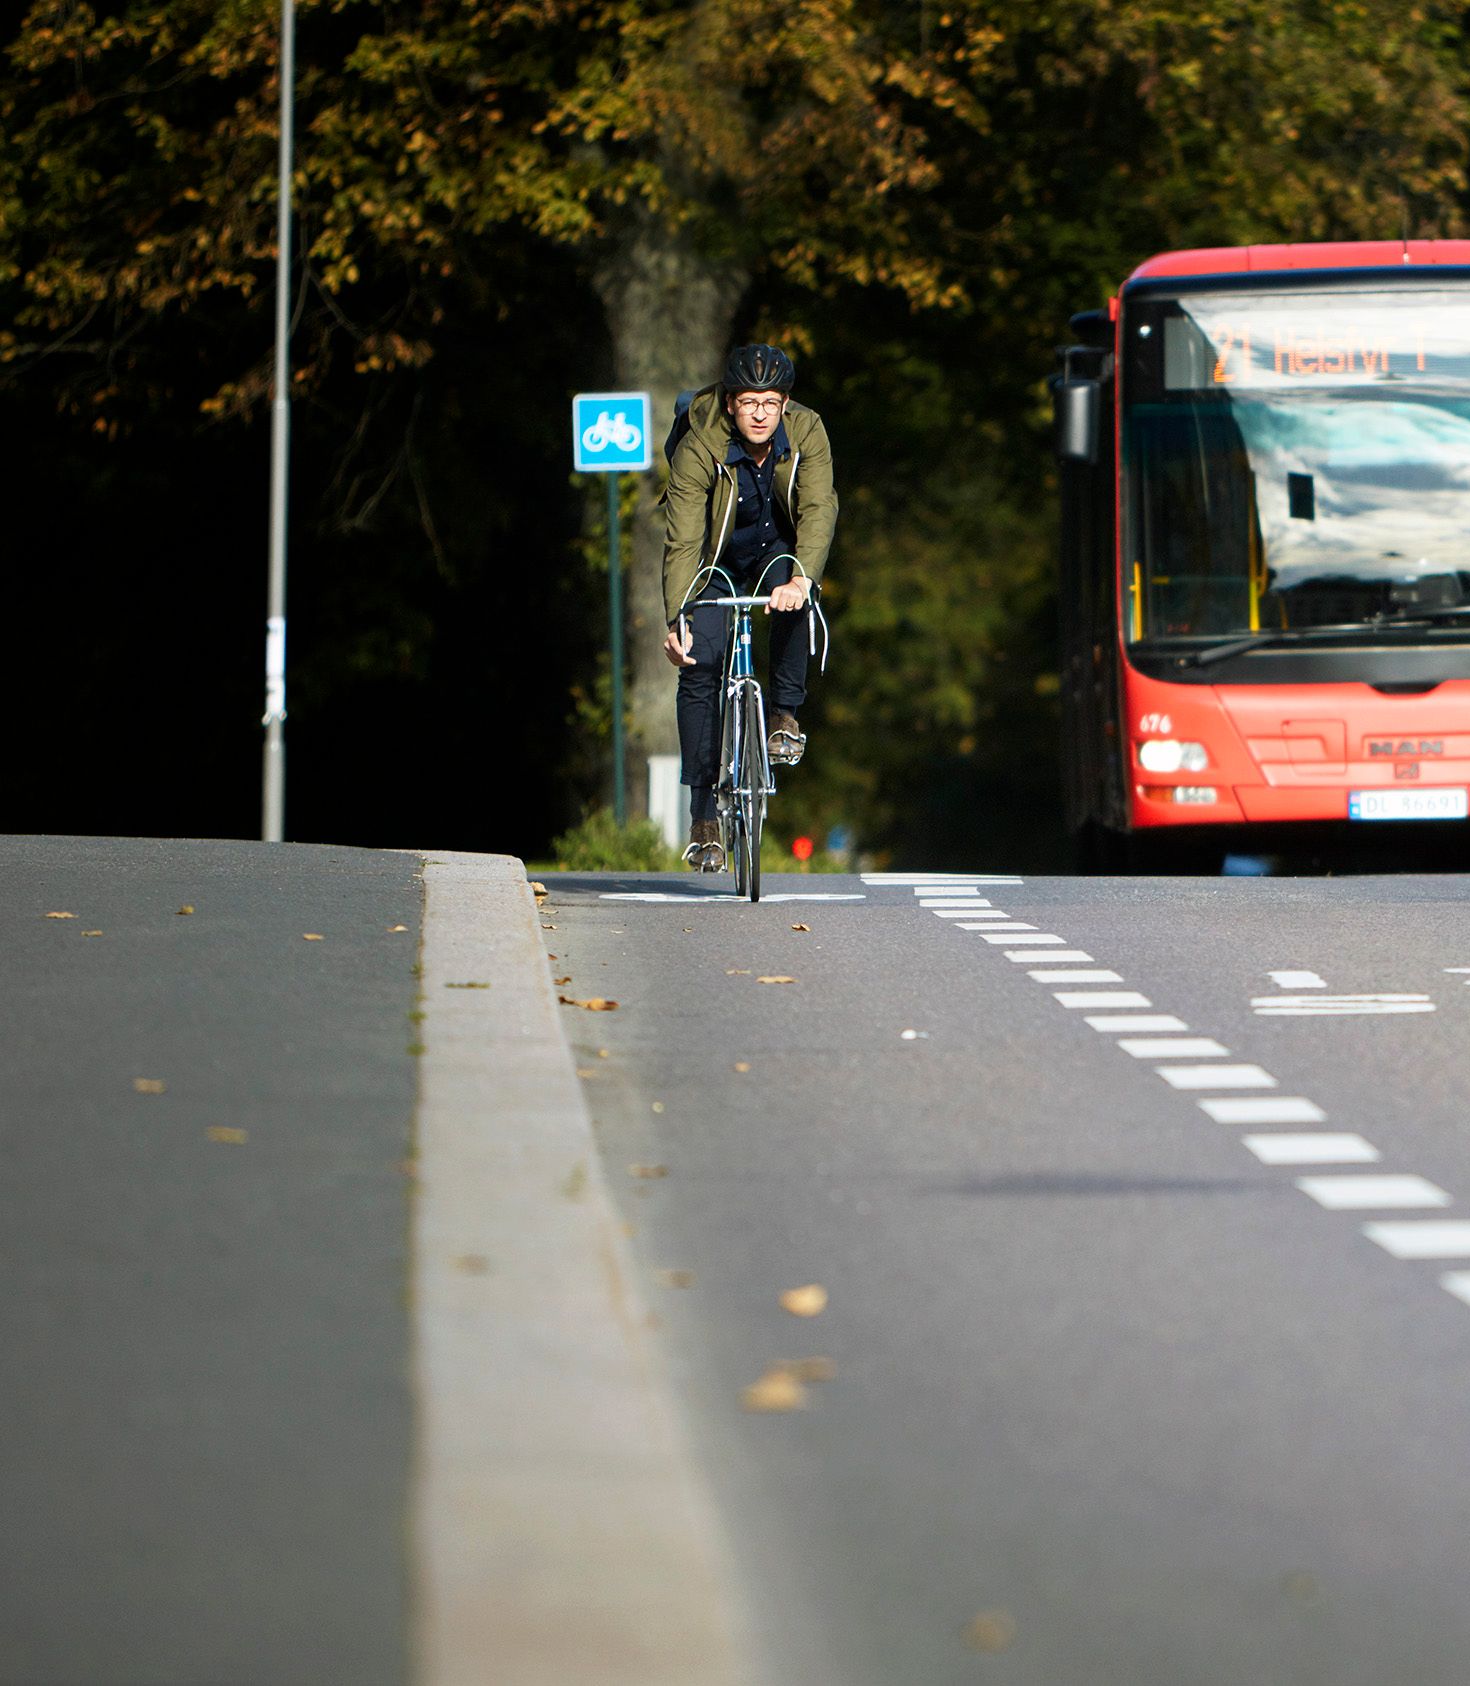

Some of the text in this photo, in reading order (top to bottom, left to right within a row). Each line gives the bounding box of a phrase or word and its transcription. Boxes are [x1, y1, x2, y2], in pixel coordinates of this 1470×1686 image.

[1212, 322, 1251, 383] 21
[1274, 326, 1397, 375] Helsfyr
[1139, 713, 1172, 734] 676
[1369, 741, 1443, 756] MAN
